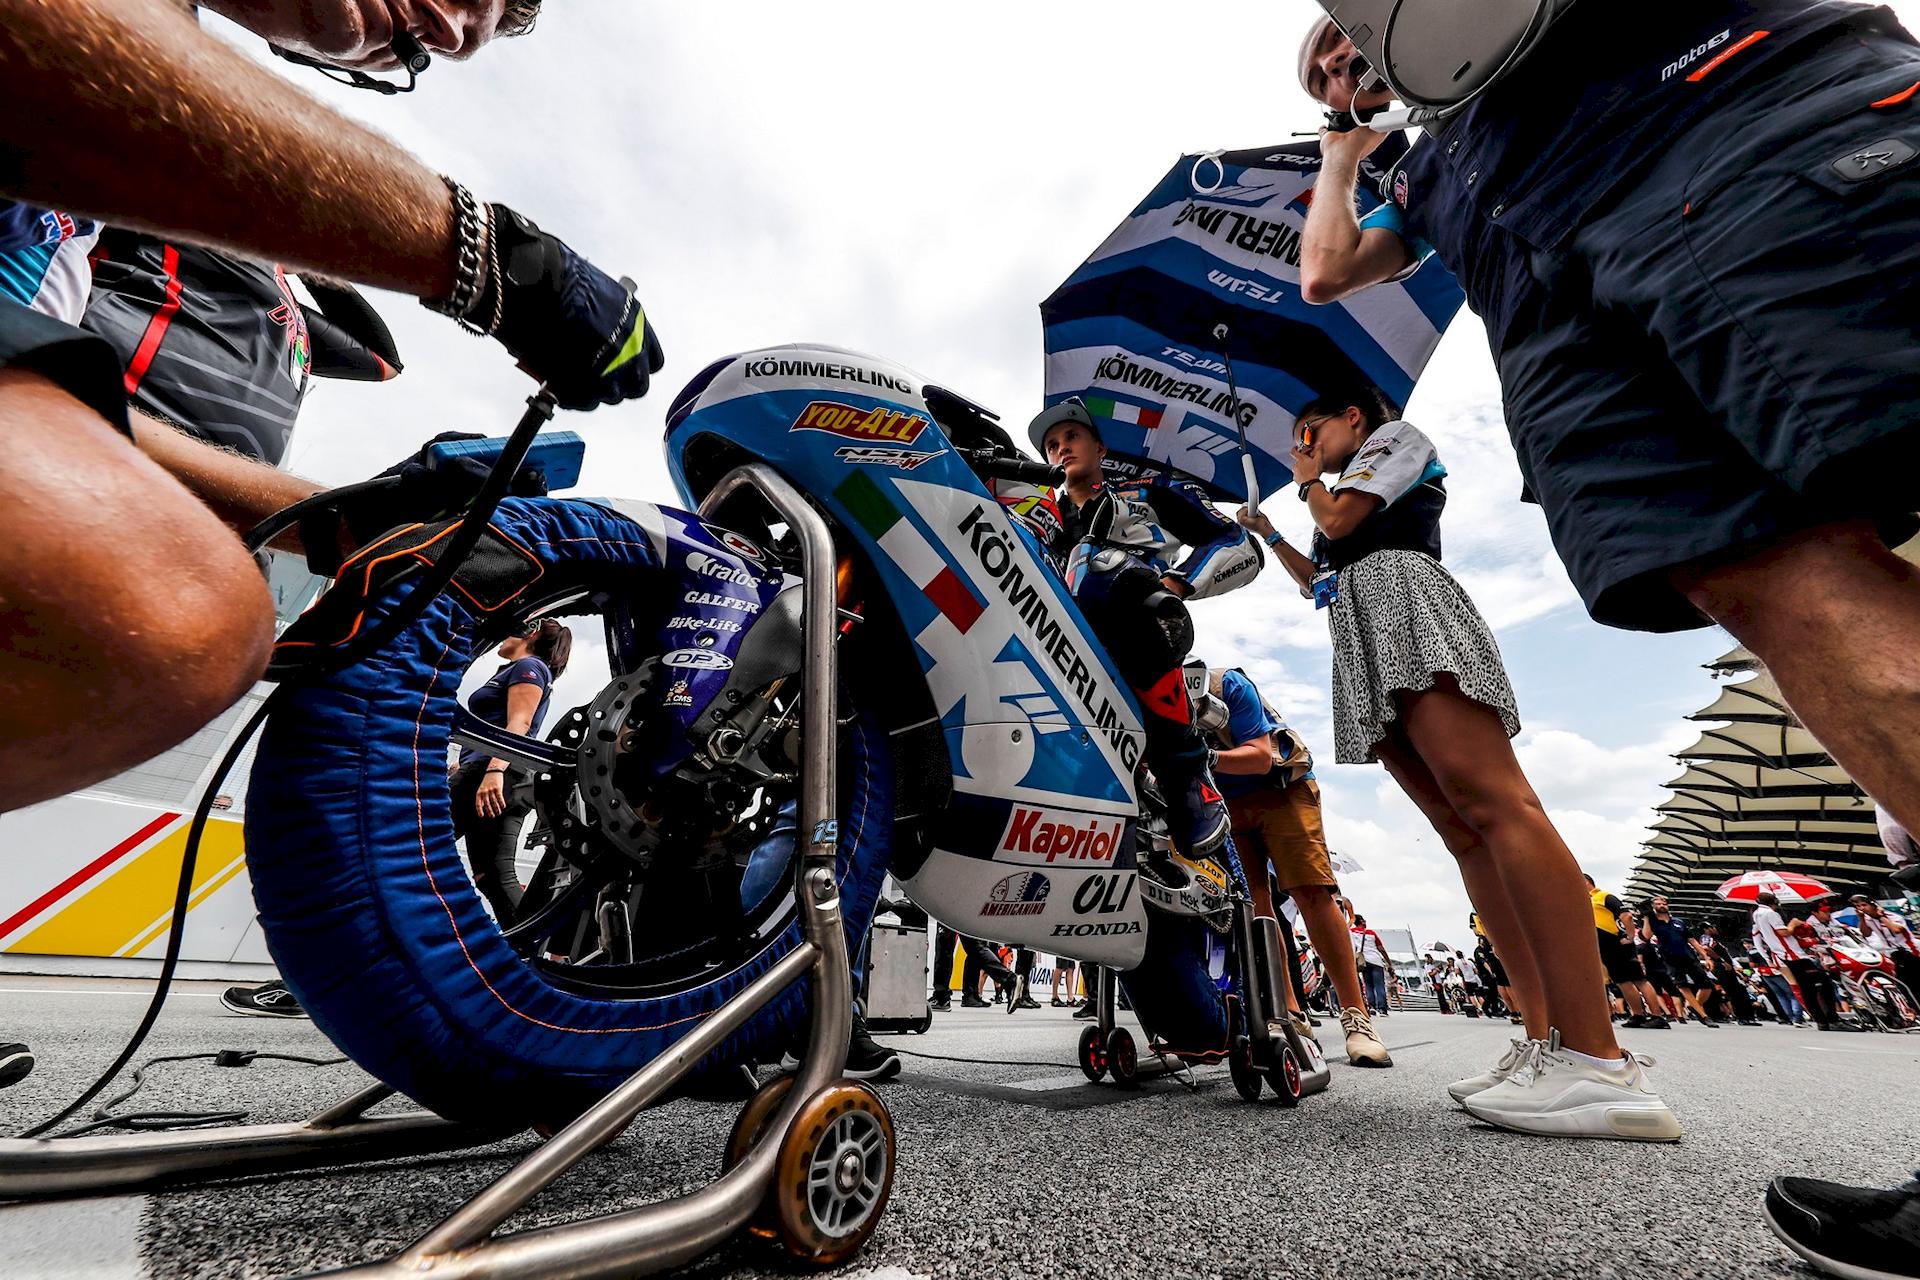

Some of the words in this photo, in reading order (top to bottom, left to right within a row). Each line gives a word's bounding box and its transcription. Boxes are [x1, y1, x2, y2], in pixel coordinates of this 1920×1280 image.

[1207, 269, 1283, 303] TEAM
[745, 357, 911, 394] KÖMMERLING
[1093, 353, 1258, 428] KÖMMERLING
[803, 405, 914, 441] YOU-ALL
[697, 554, 761, 589] Kratos
[684, 591, 760, 614] GALFER
[667, 617, 742, 633] Bike-Lift
[957, 504, 1138, 773] KÖMMERLING
[1003, 808, 1121, 862] Kapriol
[1194, 860, 1222, 880] UNLOP
[979, 902, 1046, 916] AMERICANINO
[1072, 873, 1137, 915] OLI
[1050, 921, 1142, 936] HONDA
